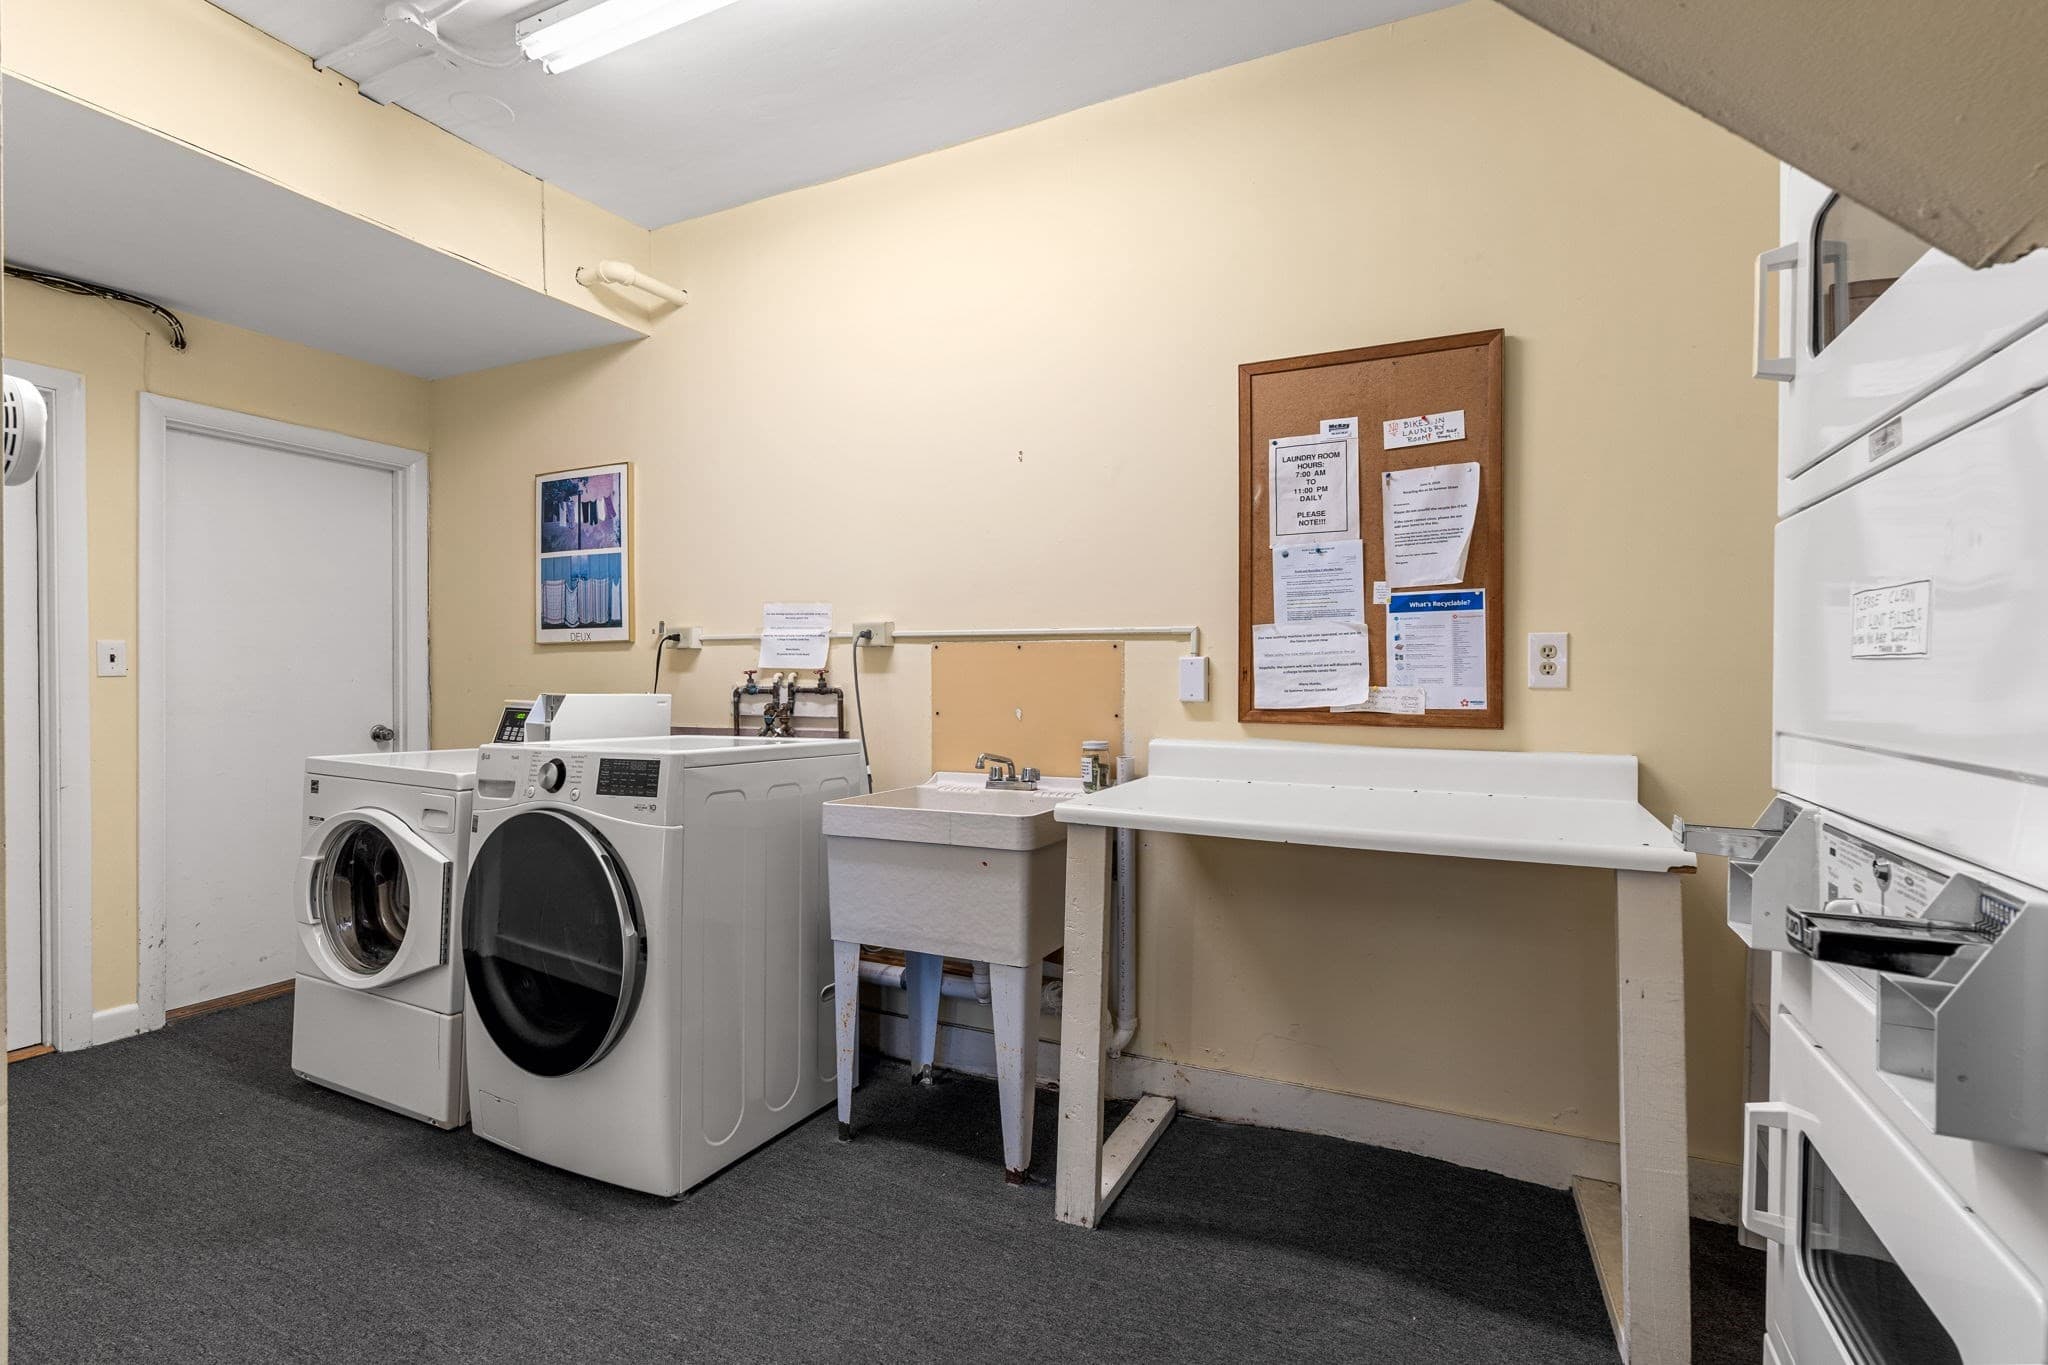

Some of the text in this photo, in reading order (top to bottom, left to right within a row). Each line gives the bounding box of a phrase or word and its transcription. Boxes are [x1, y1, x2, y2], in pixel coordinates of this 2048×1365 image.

[1403, 424, 1444, 436] LAUNDRY
[1282, 454, 1316, 463] LAUNDRY
[1297, 510, 1326, 518] PLEASE
[570, 632, 592, 642] DEUX
